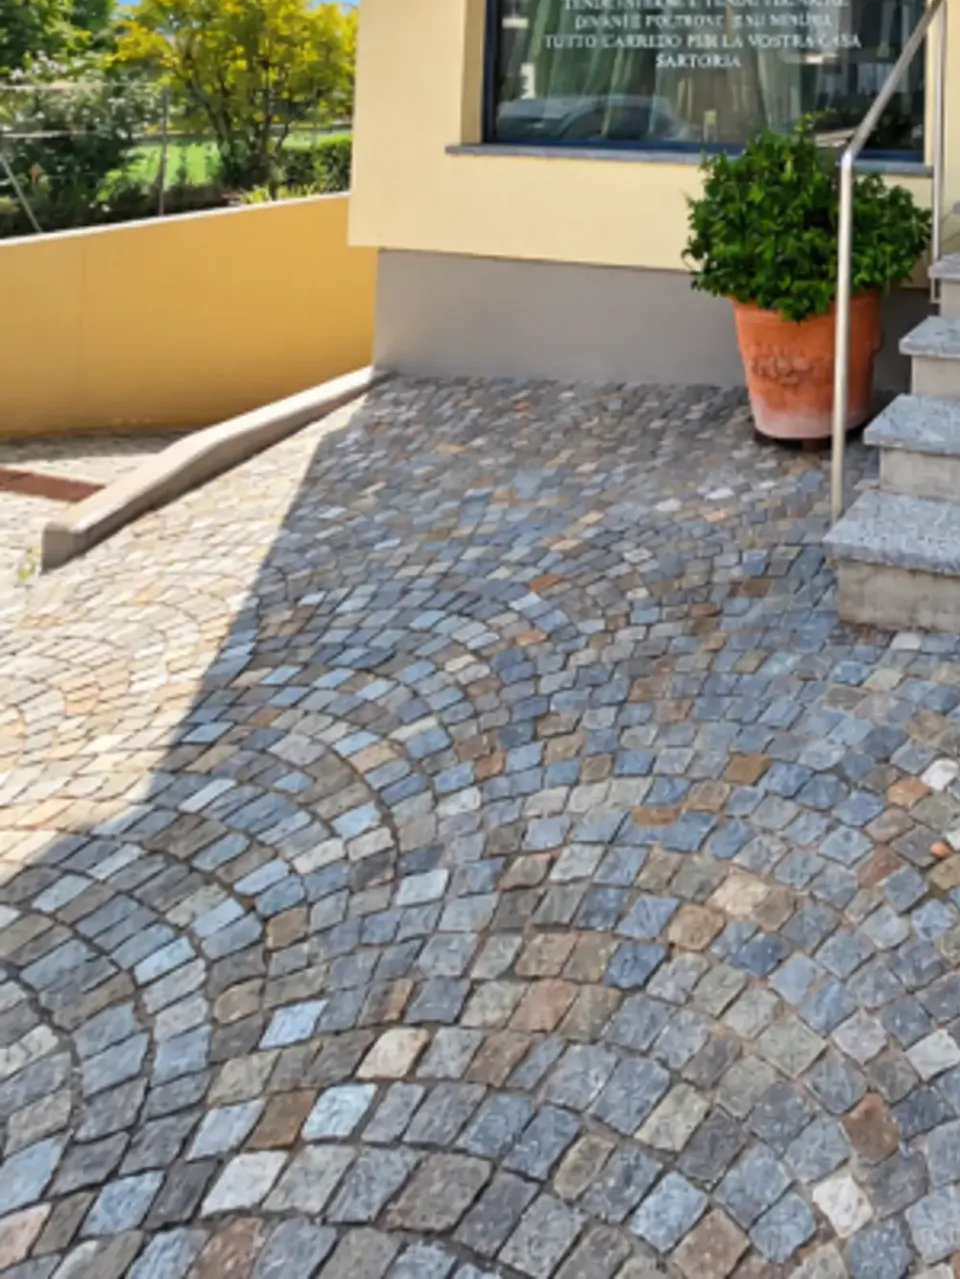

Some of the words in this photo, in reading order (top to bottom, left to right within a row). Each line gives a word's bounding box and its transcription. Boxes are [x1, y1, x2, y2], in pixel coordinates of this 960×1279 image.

[544, 34, 597, 49] TUTTO
[687, 34, 718, 48] PER
[722, 33, 744, 48] LA
[748, 32, 817, 48] VOSTRA
[819, 32, 863, 48] CASA
[656, 52, 742, 69] SARTORIA
